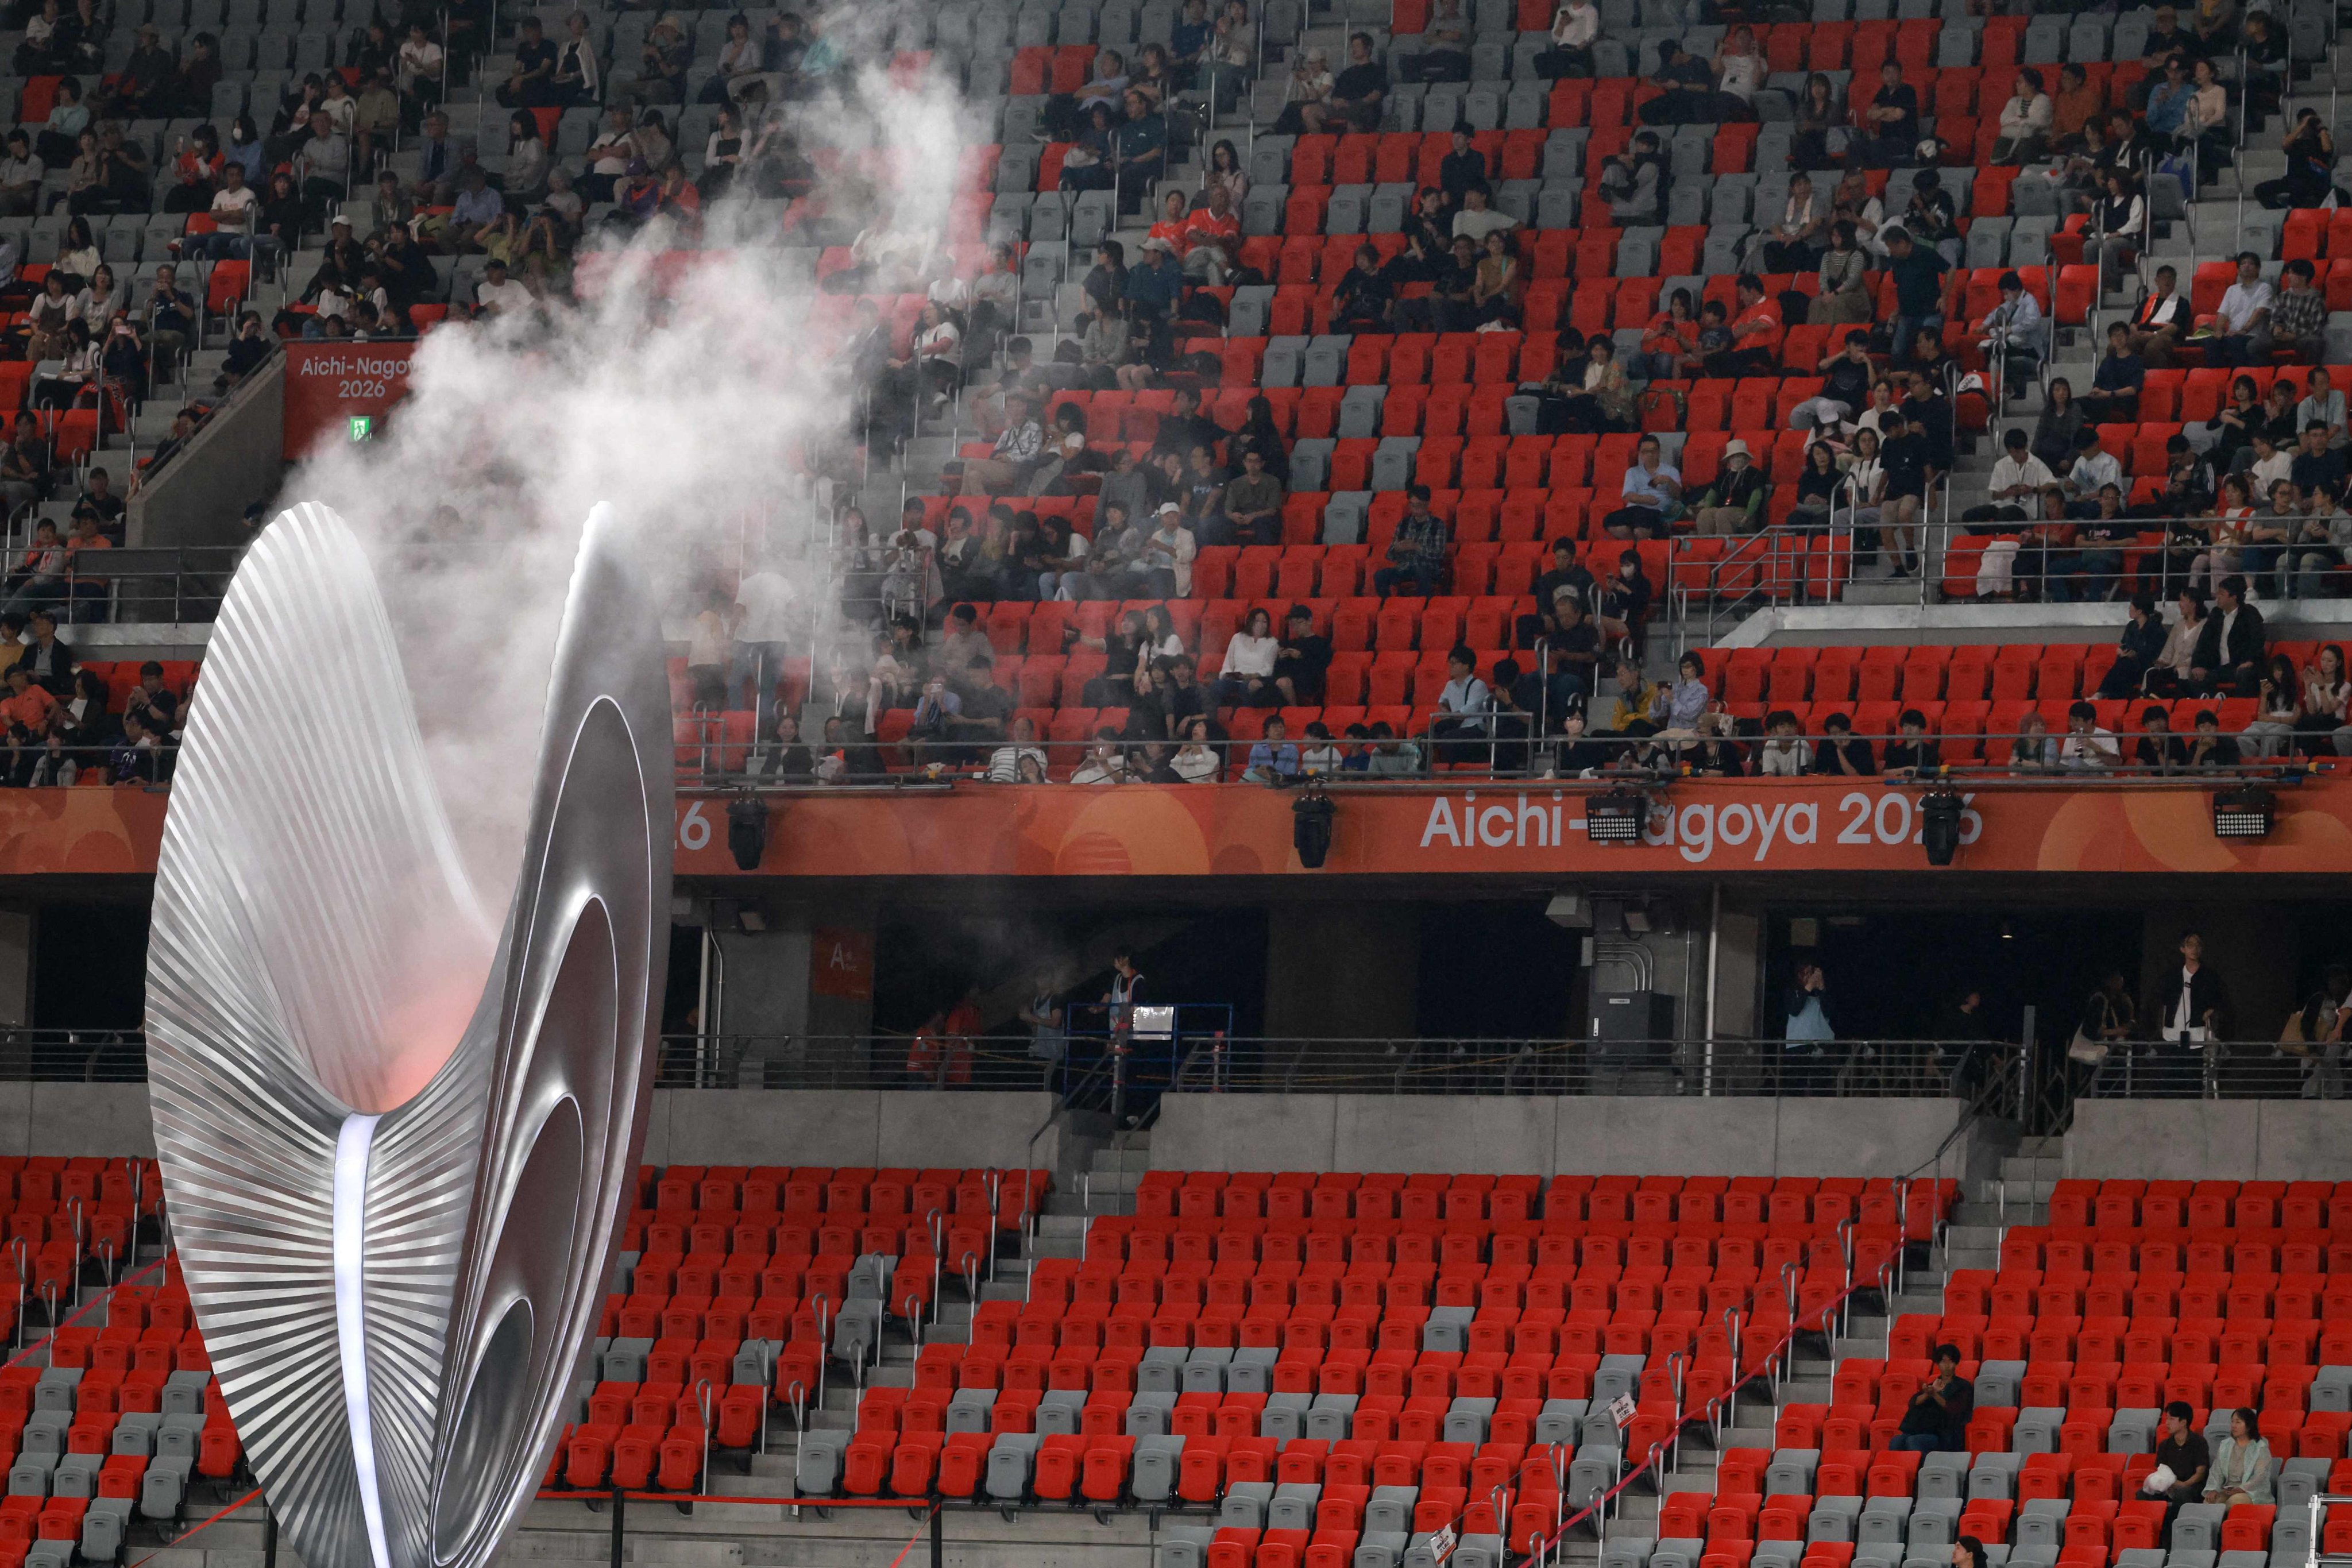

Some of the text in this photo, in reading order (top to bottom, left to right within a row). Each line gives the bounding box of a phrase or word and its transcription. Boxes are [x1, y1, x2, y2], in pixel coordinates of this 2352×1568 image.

[338, 380, 385, 397] 2026
[1420, 789, 1983, 863] Aichi-agoya 206
